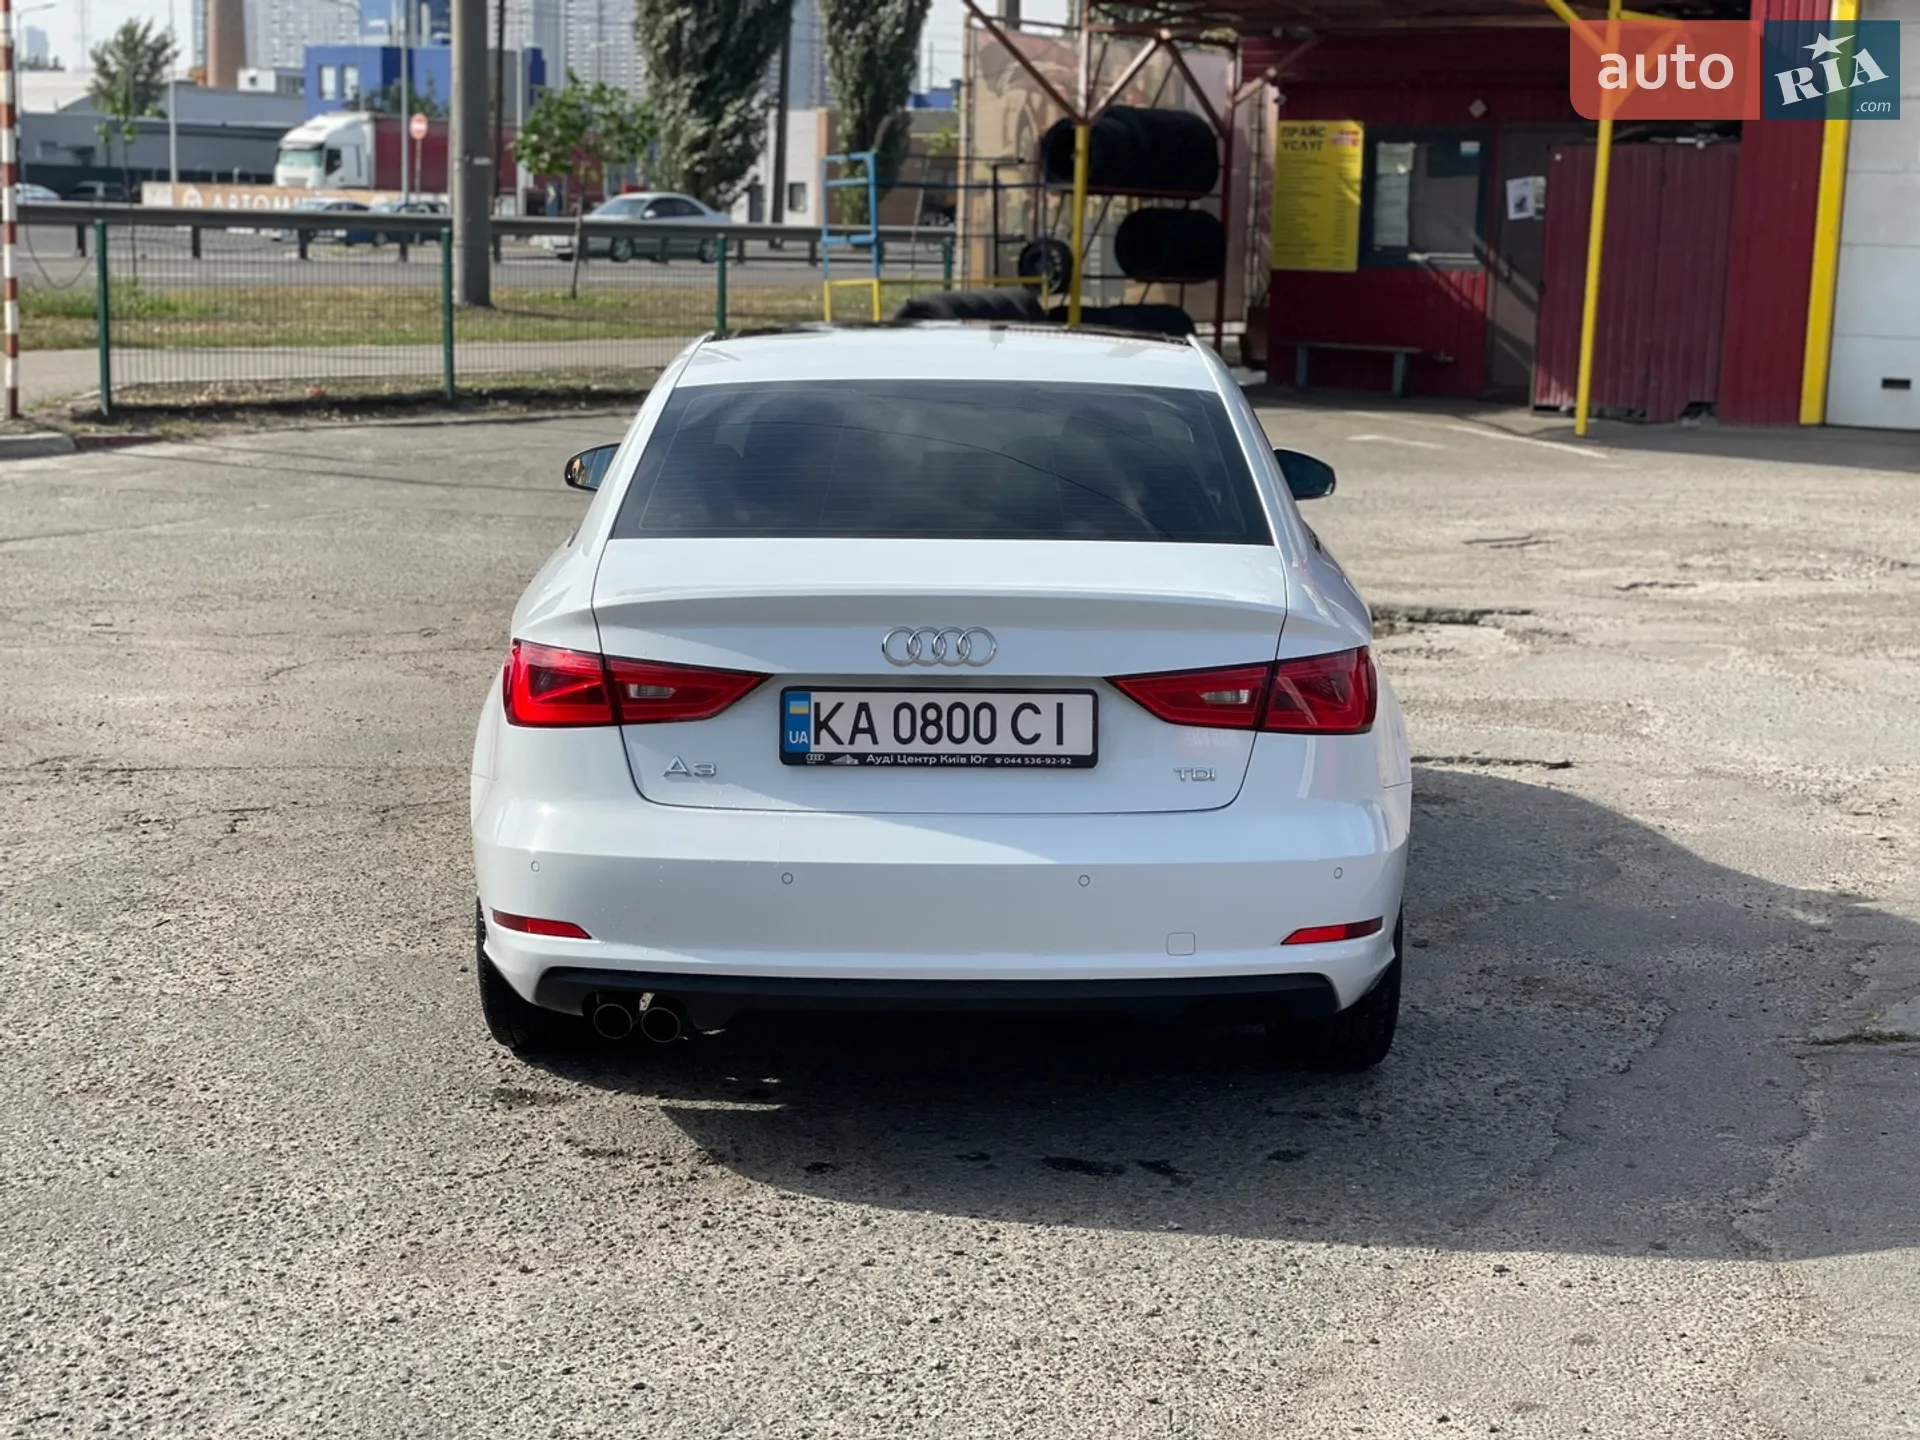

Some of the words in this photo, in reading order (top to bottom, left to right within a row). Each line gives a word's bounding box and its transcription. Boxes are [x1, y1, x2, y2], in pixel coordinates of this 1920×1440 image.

[813, 701, 879, 746] KA
[893, 701, 998, 746] 0800
[789, 730, 809, 744] UA
[663, 755, 717, 778] A3
[866, 754, 894, 764] Ауді
[897, 755, 937, 765] Центр
[940, 754, 967, 764] Київ
[970, 755, 988, 764] Юг
[1004, 757, 1022, 765] 044
[1173, 766, 1216, 782] TDI
